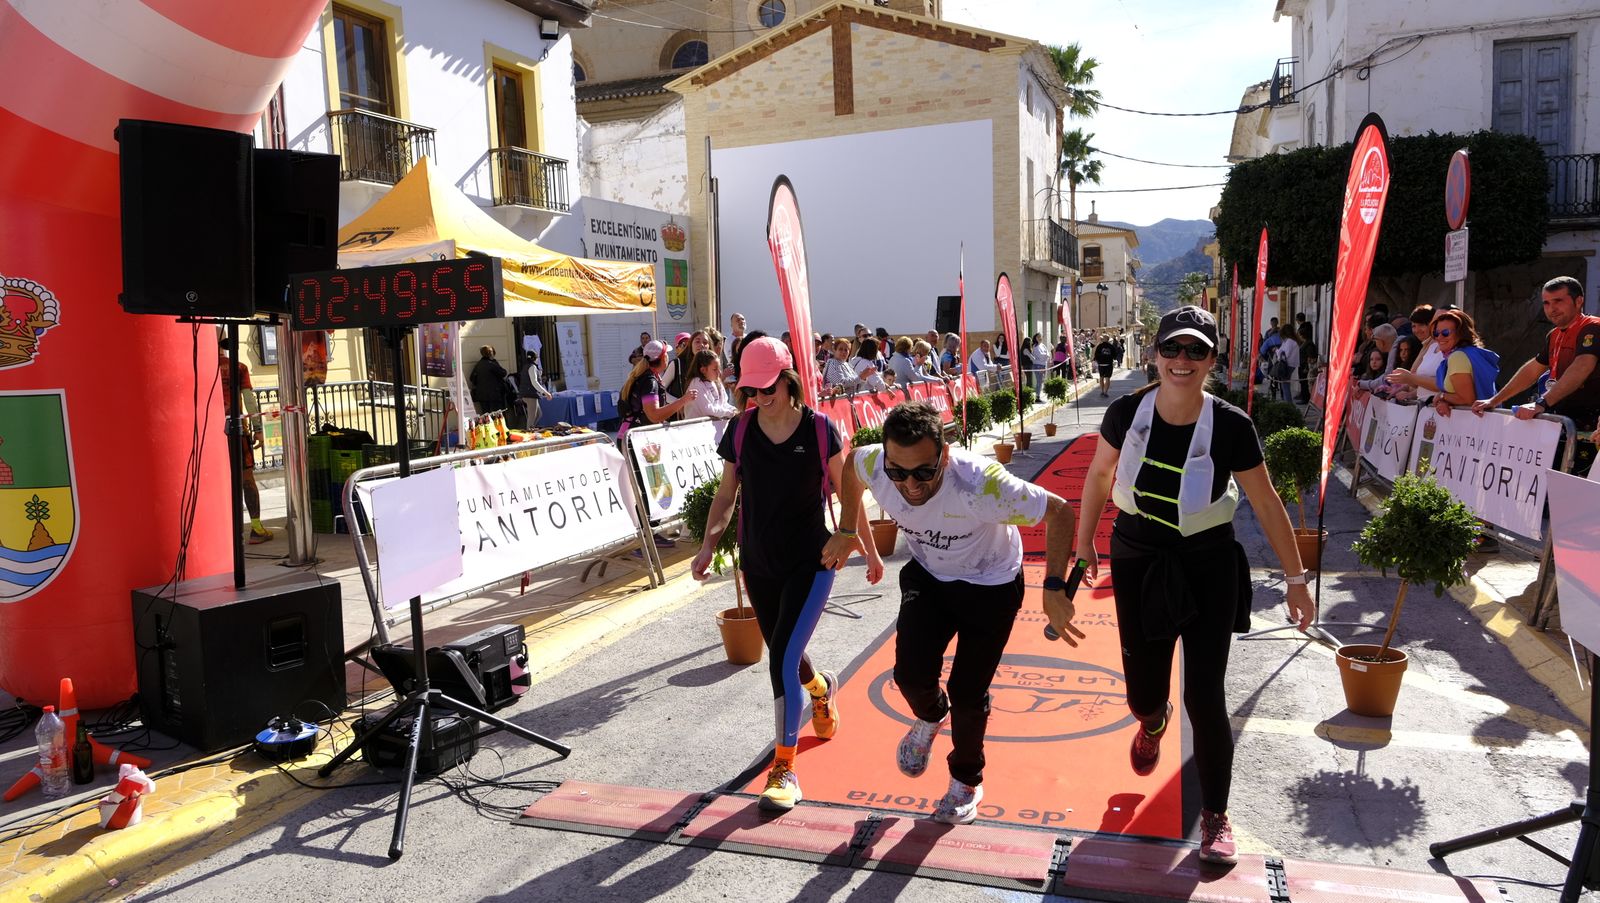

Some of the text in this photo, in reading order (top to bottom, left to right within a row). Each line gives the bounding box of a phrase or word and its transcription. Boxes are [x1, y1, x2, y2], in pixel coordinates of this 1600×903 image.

[590, 218, 657, 242] EXCELENTÍSIMO
[594, 242, 658, 263] AYUNTAMIENTO
[299, 263, 488, 325] 02:49:55
[671, 443, 719, 460] AYUNTA
[1440, 433, 1524, 462] AYNTAMIETO
[457, 467, 611, 516] UNTAMIENTO DE
[459, 487, 623, 556] ANTORIA
[846, 790, 1066, 825] de Ctoria
